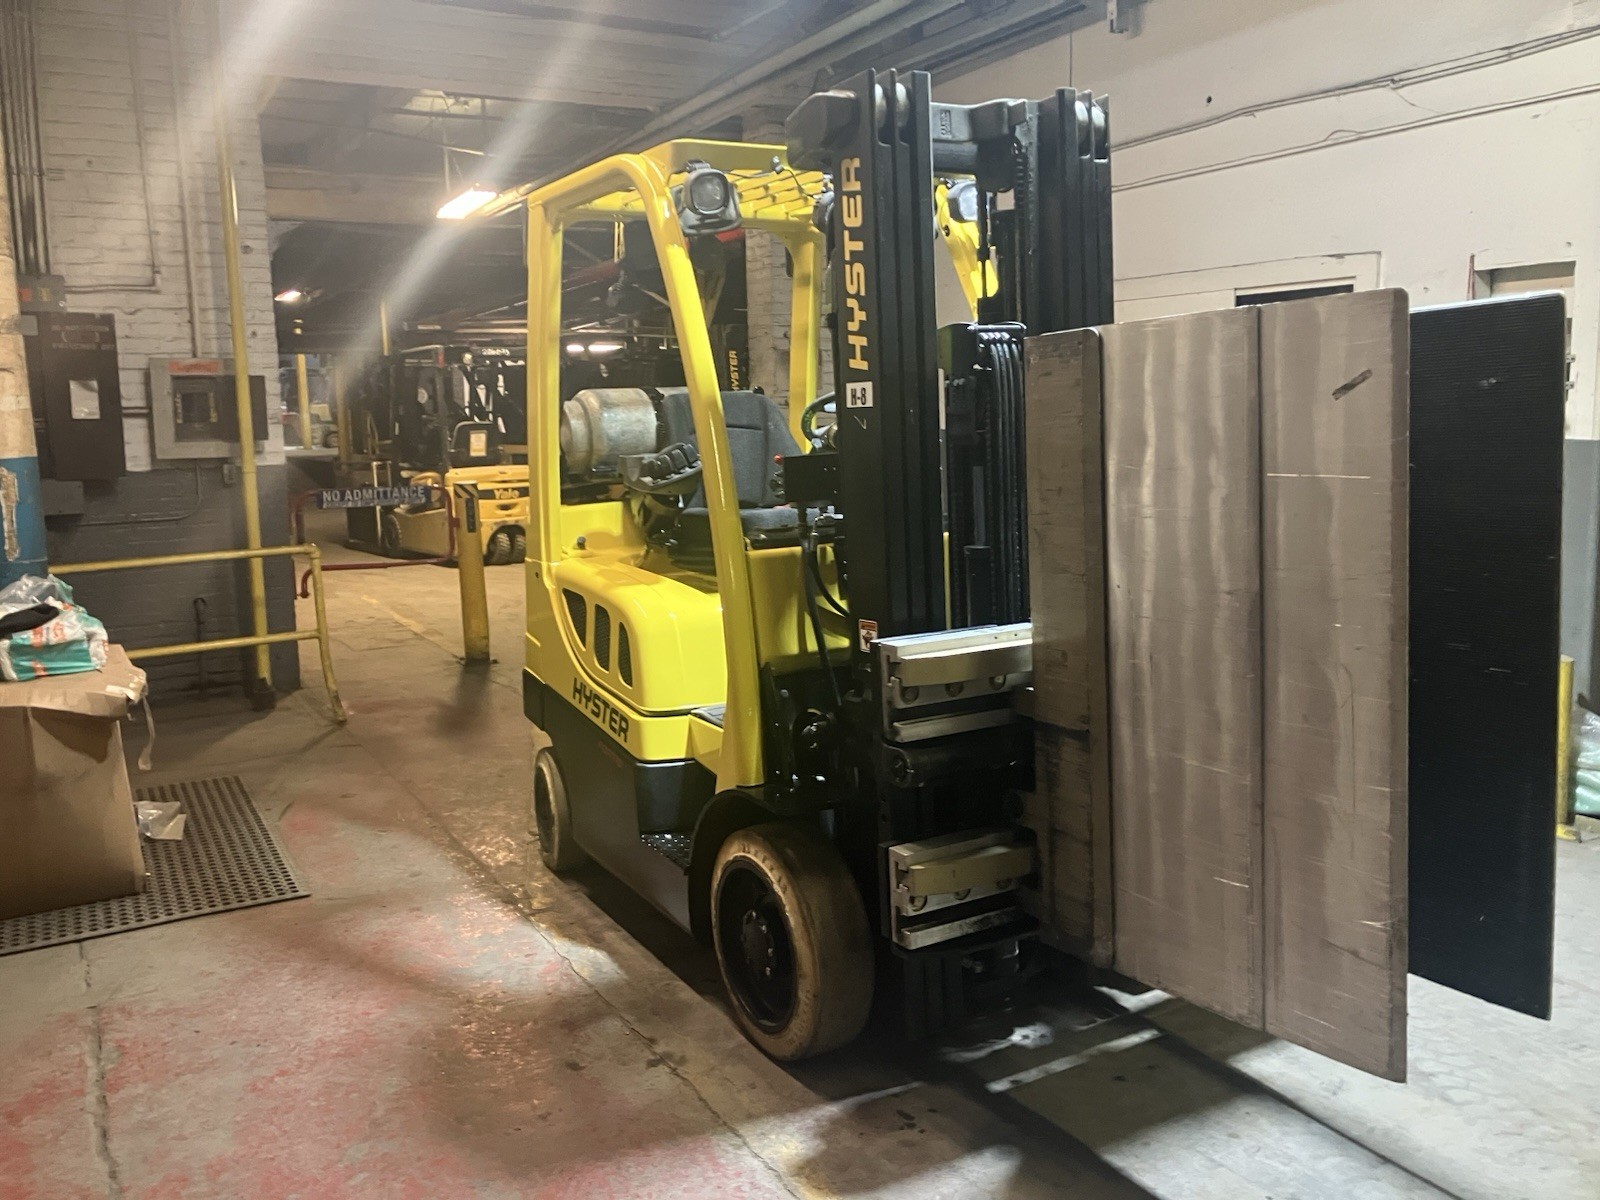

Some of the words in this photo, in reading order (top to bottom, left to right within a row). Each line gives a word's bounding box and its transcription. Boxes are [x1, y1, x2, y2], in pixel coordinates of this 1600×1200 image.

[840, 157, 870, 371] HYSTER
[850, 387, 867, 406] H-8
[322, 490, 341, 502] NO
[344, 486, 425, 501] ADMITTANCE
[494, 487, 520, 499] Yale
[572, 677, 629, 743] HYSTER
